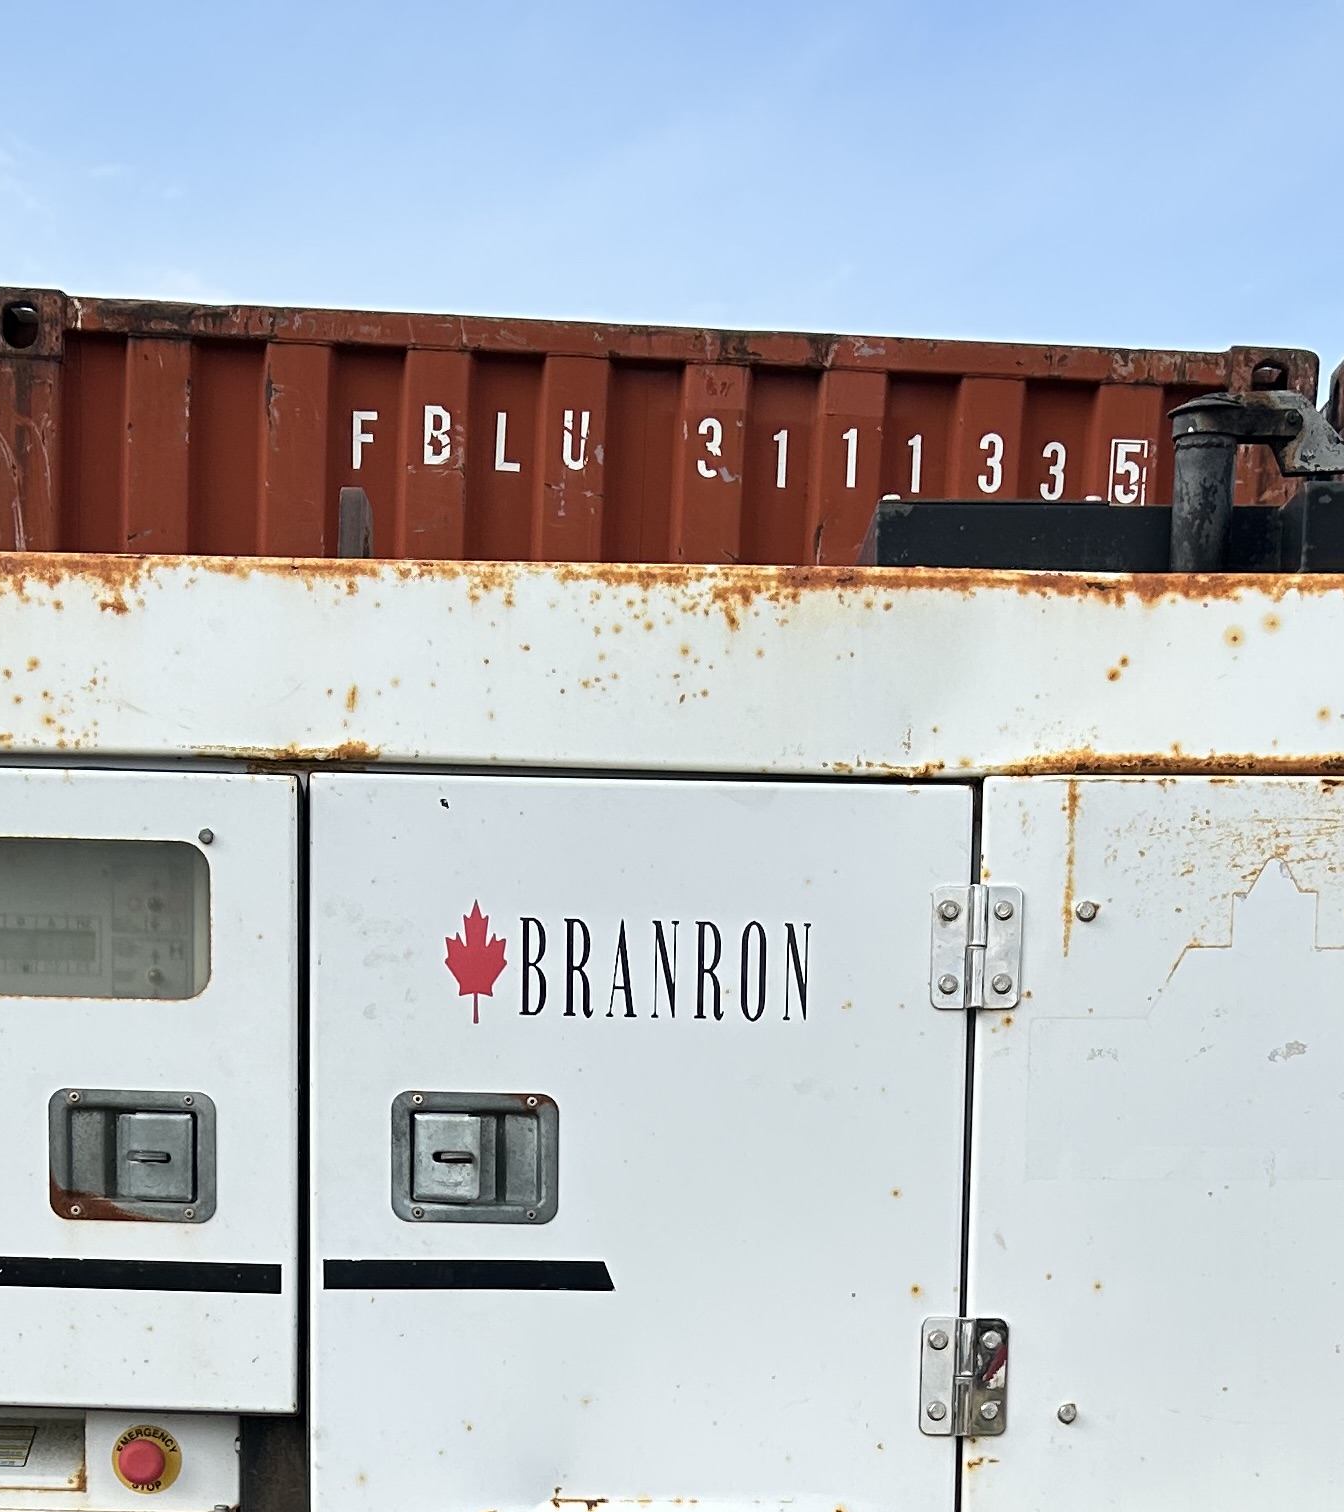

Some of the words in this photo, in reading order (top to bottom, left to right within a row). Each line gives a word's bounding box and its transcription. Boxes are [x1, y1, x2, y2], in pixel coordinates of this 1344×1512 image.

[350, 404, 591, 472] FBLU
[518, 915, 813, 1023] BRANRON
[116, 1427, 178, 1453] EMERGENCY
